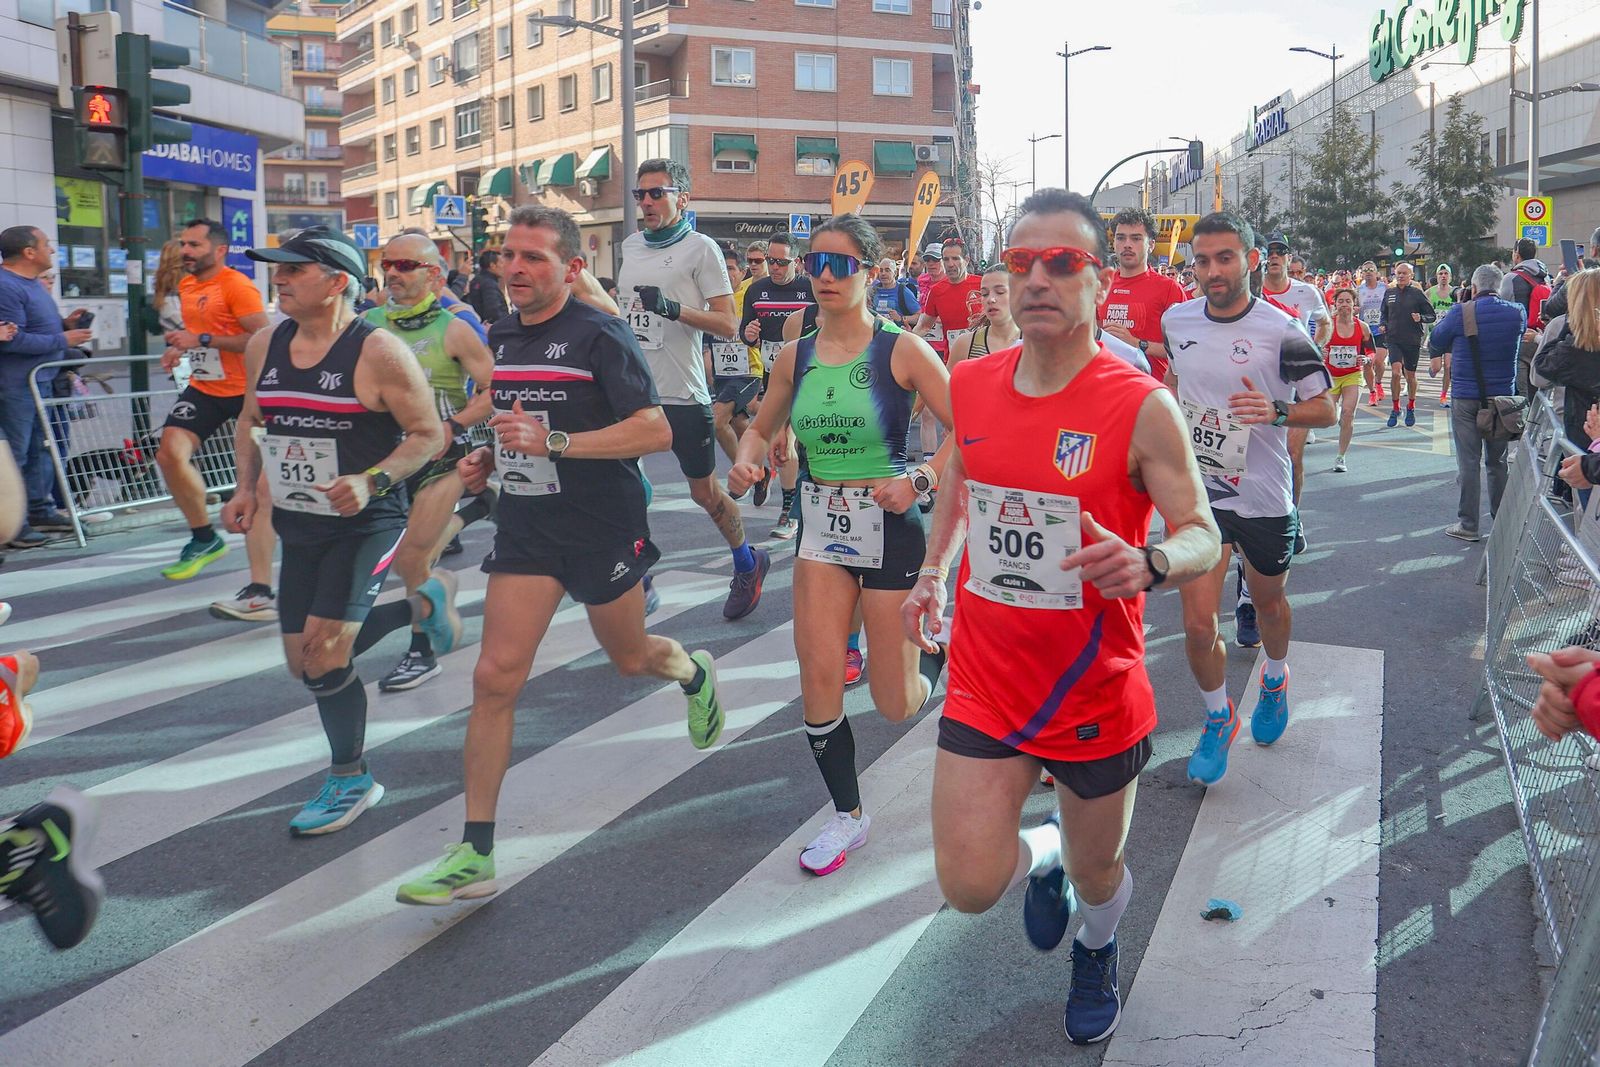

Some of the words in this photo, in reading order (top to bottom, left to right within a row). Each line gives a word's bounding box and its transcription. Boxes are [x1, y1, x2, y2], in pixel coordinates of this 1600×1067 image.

[734, 222, 773, 233] Puerta
[626, 313, 650, 328] 113
[1106, 309, 1129, 320] PADRE
[720, 354, 738, 363] 790
[494, 387, 568, 402] rundata
[1193, 426, 1227, 450] 857
[280, 462, 315, 483] 513
[826, 512, 851, 534] 79
[988, 525, 1044, 560] 506
[999, 558, 1031, 571] FRANCIS
